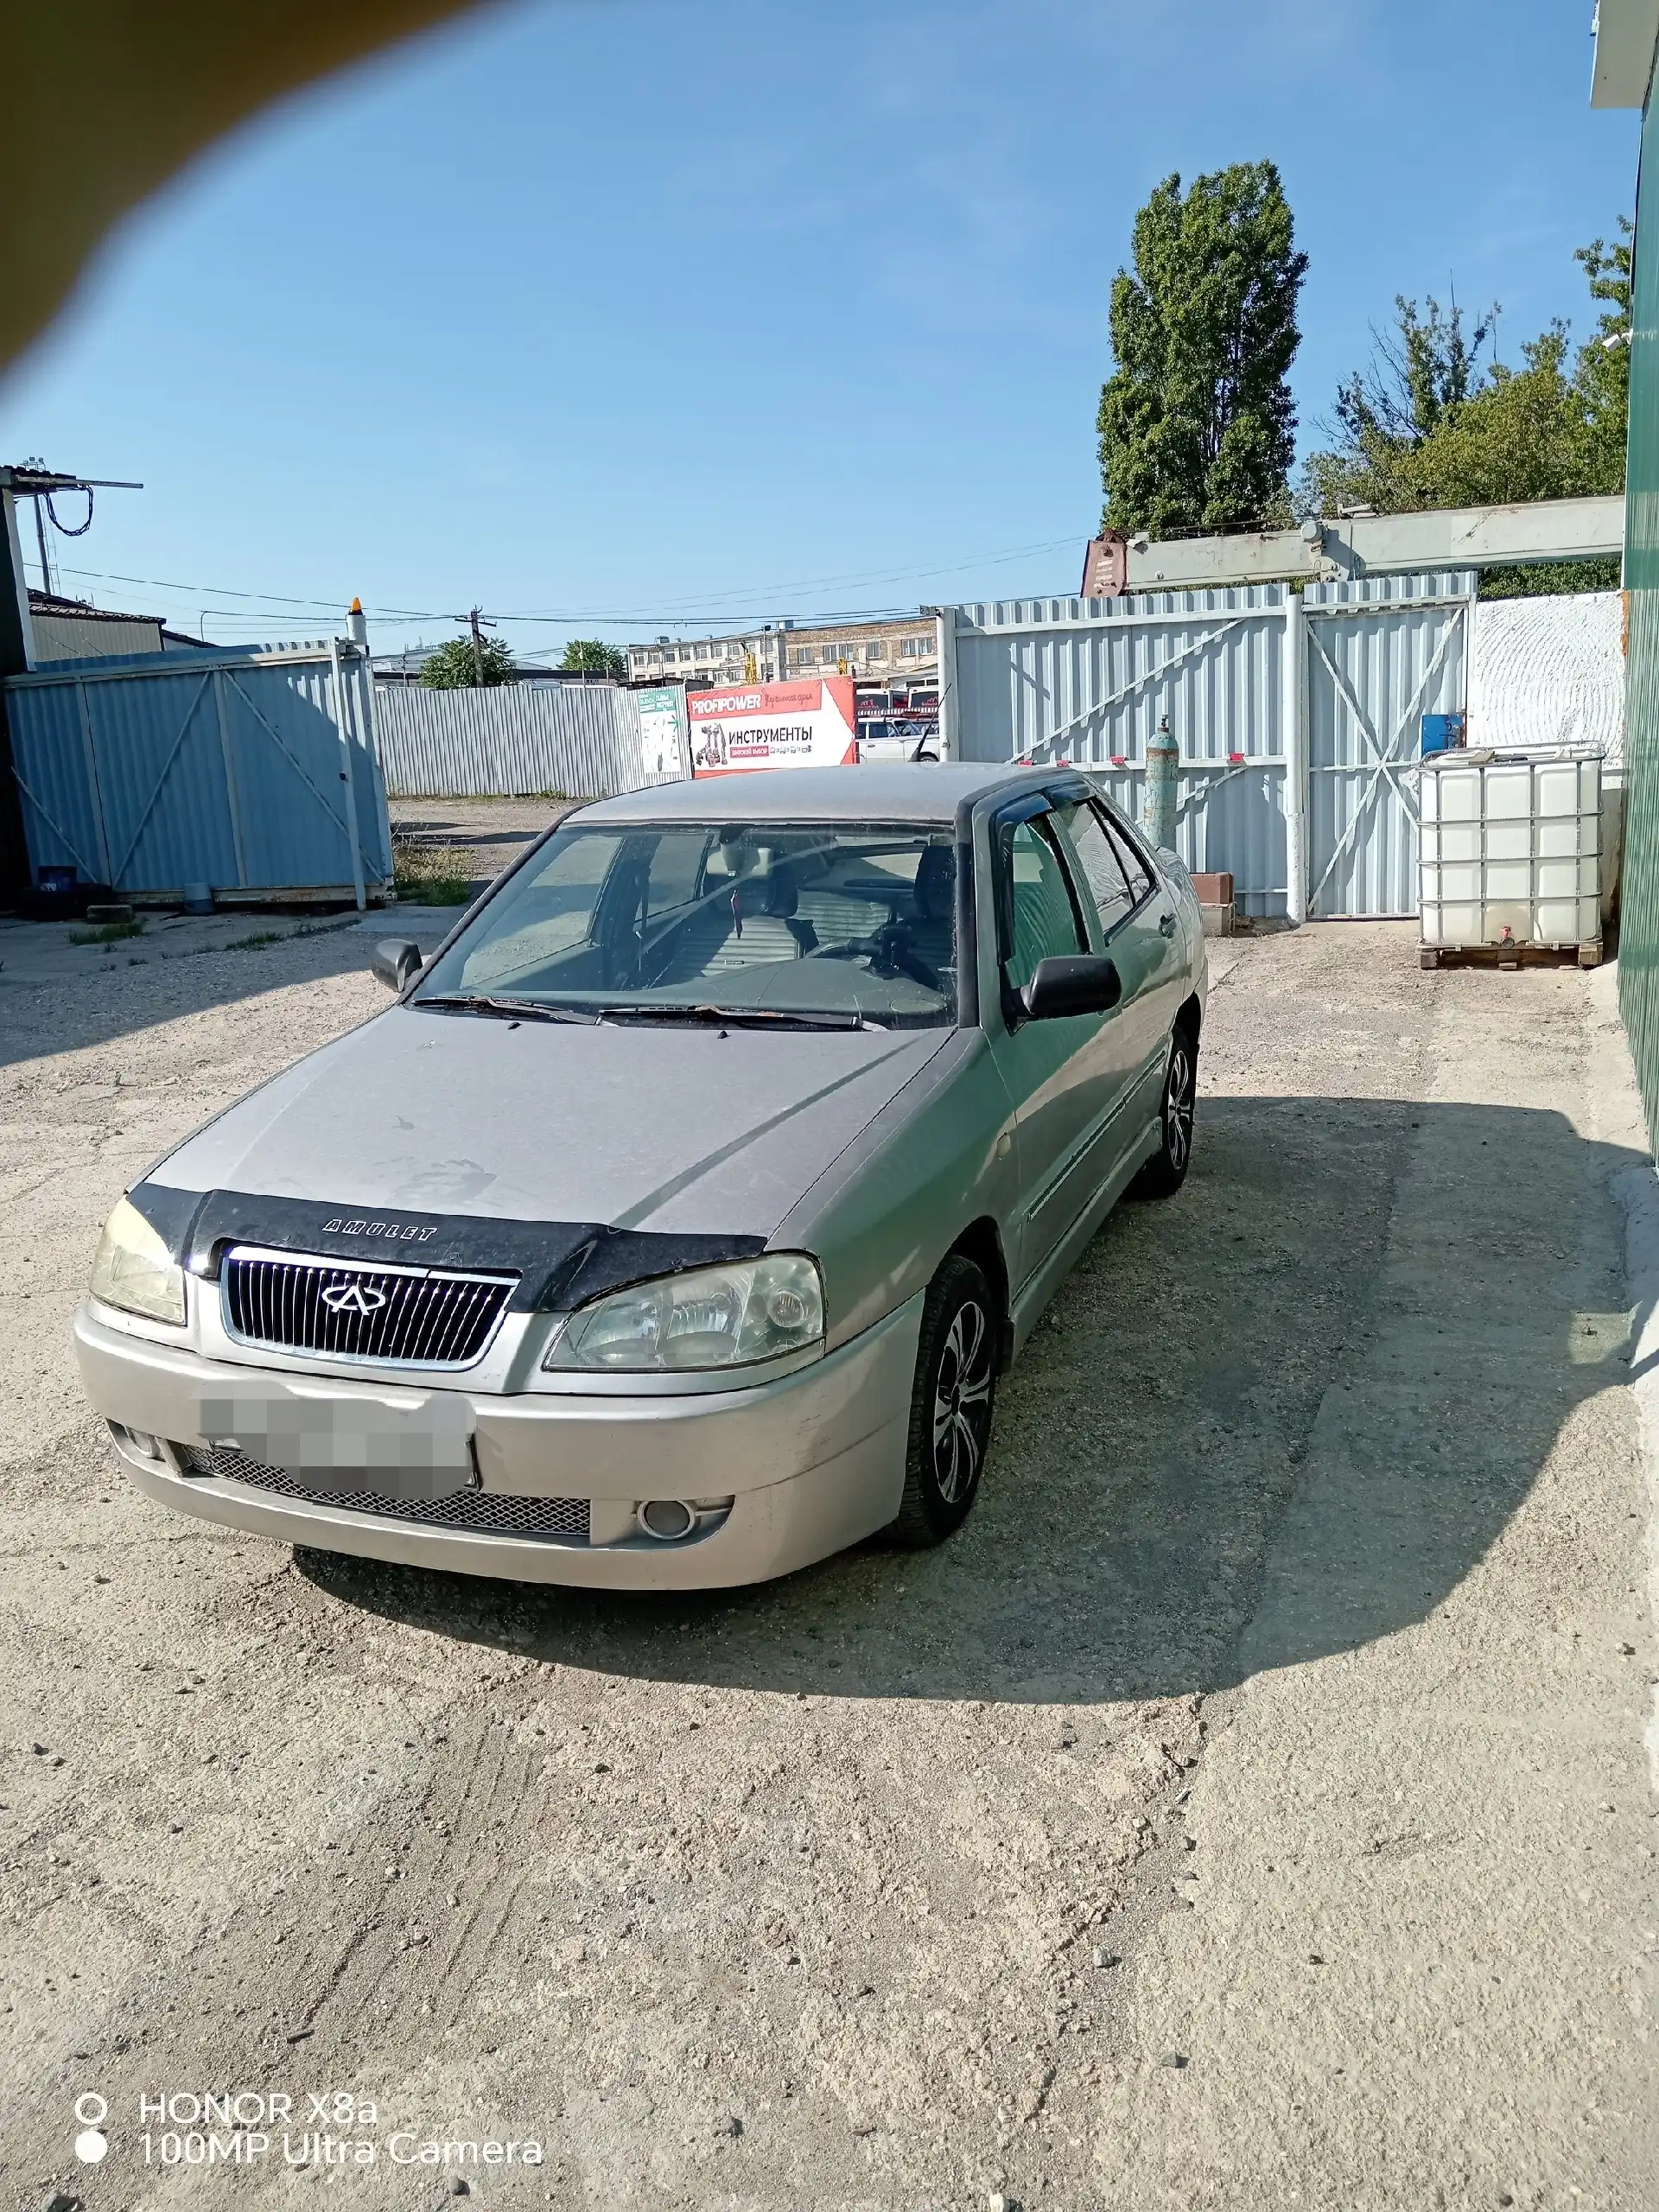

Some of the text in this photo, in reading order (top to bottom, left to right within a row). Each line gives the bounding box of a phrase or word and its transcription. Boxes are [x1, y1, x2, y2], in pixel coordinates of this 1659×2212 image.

[691, 694, 762, 715] PROFIPOWER
[728, 726, 812, 745] ИНСТРУМЕНТЫ
[322, 1218, 438, 1242] AMULET
